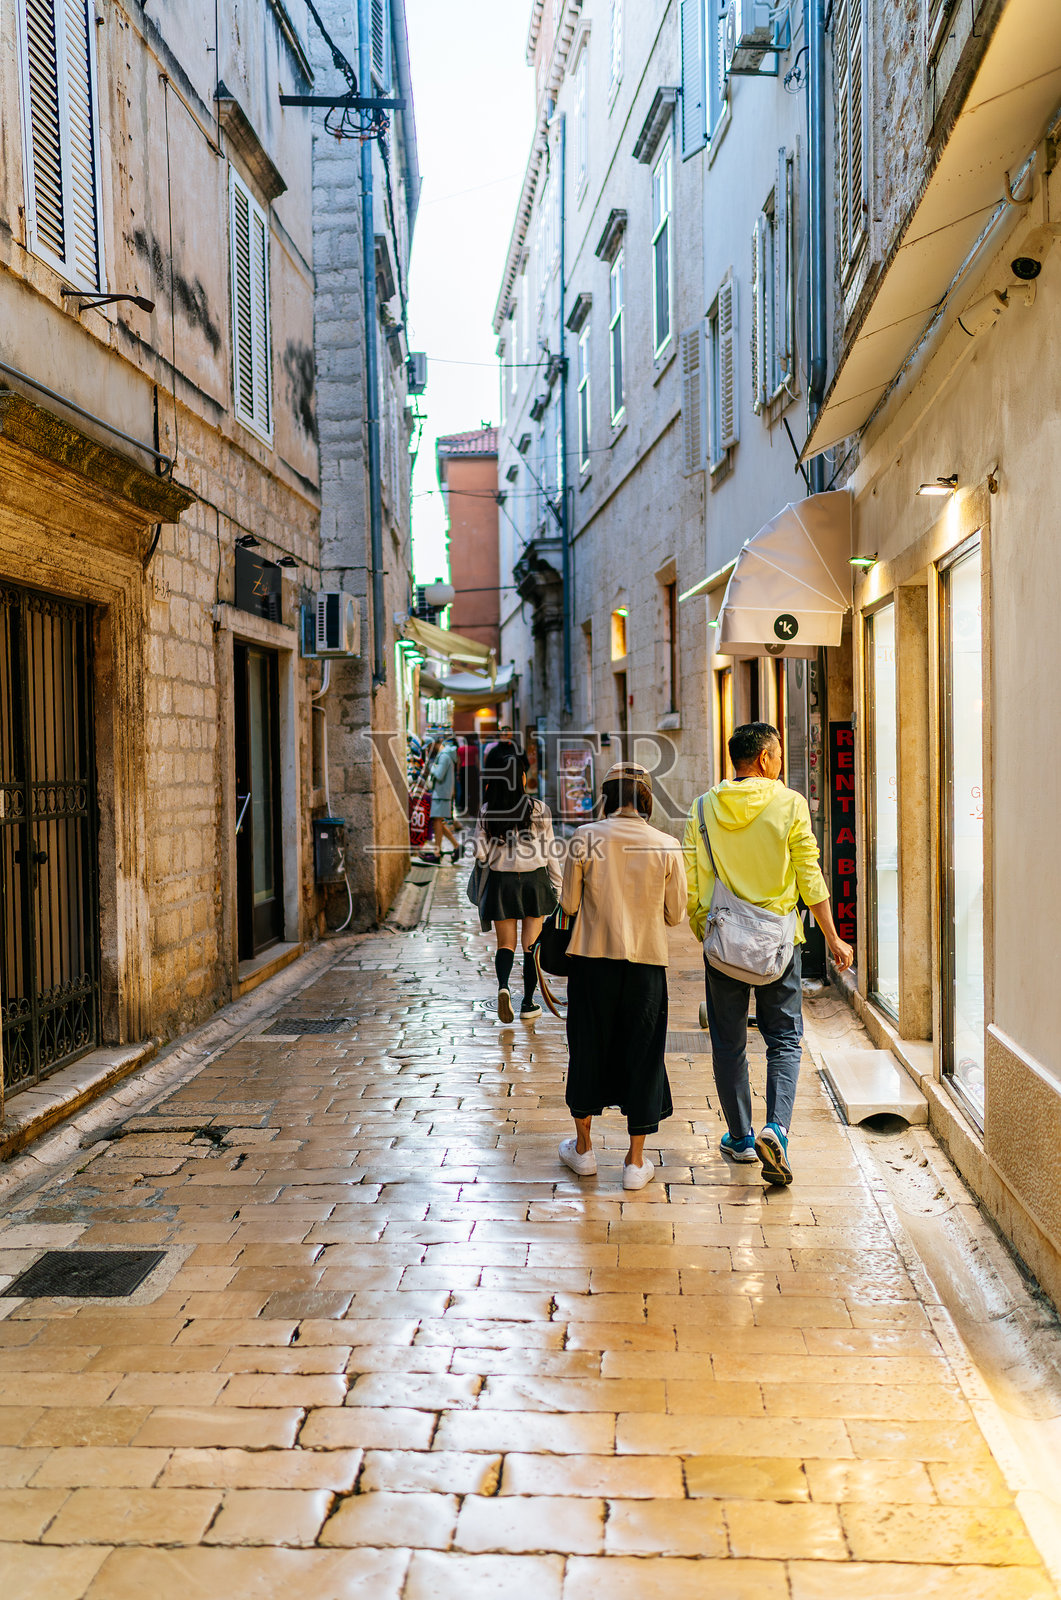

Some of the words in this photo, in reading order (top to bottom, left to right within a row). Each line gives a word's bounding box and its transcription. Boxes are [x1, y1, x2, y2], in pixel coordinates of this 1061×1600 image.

[836, 729, 855, 813] RENT
[836, 827, 855, 844] A
[837, 858, 856, 939] BIKE
